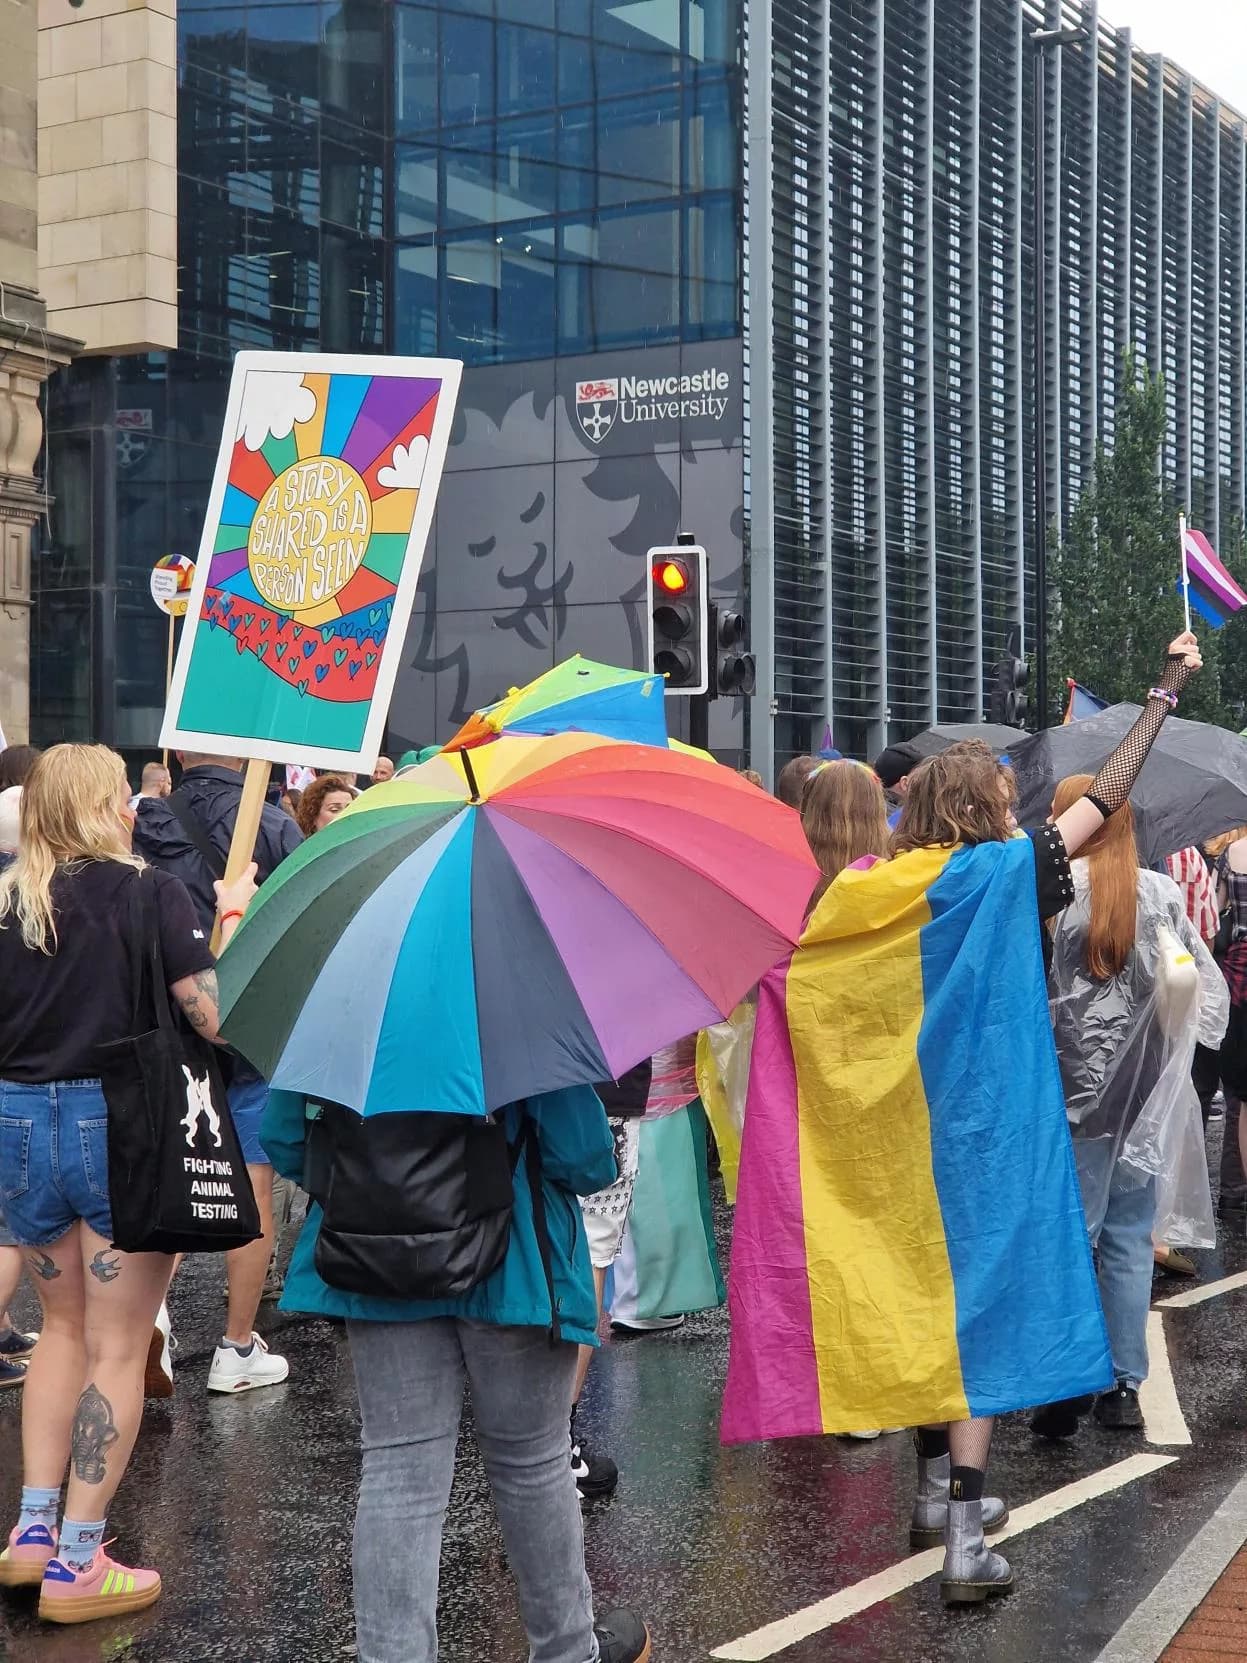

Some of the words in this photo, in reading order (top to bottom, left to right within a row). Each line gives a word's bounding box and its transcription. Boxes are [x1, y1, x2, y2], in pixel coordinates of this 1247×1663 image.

[620, 367, 729, 399] Newcastle
[620, 392, 728, 424] University
[264, 486, 280, 514] A
[284, 461, 353, 511] STORY
[252, 506, 328, 562] SHARED
[332, 499, 349, 531] IS
[349, 490, 368, 536] A
[254, 557, 308, 604] PERSON
[312, 538, 364, 601] SEEN
[183, 1157, 233, 1176] FIGHTING
[190, 1180, 235, 1197] ANIMAL
[190, 1201, 238, 1219] TESTING
